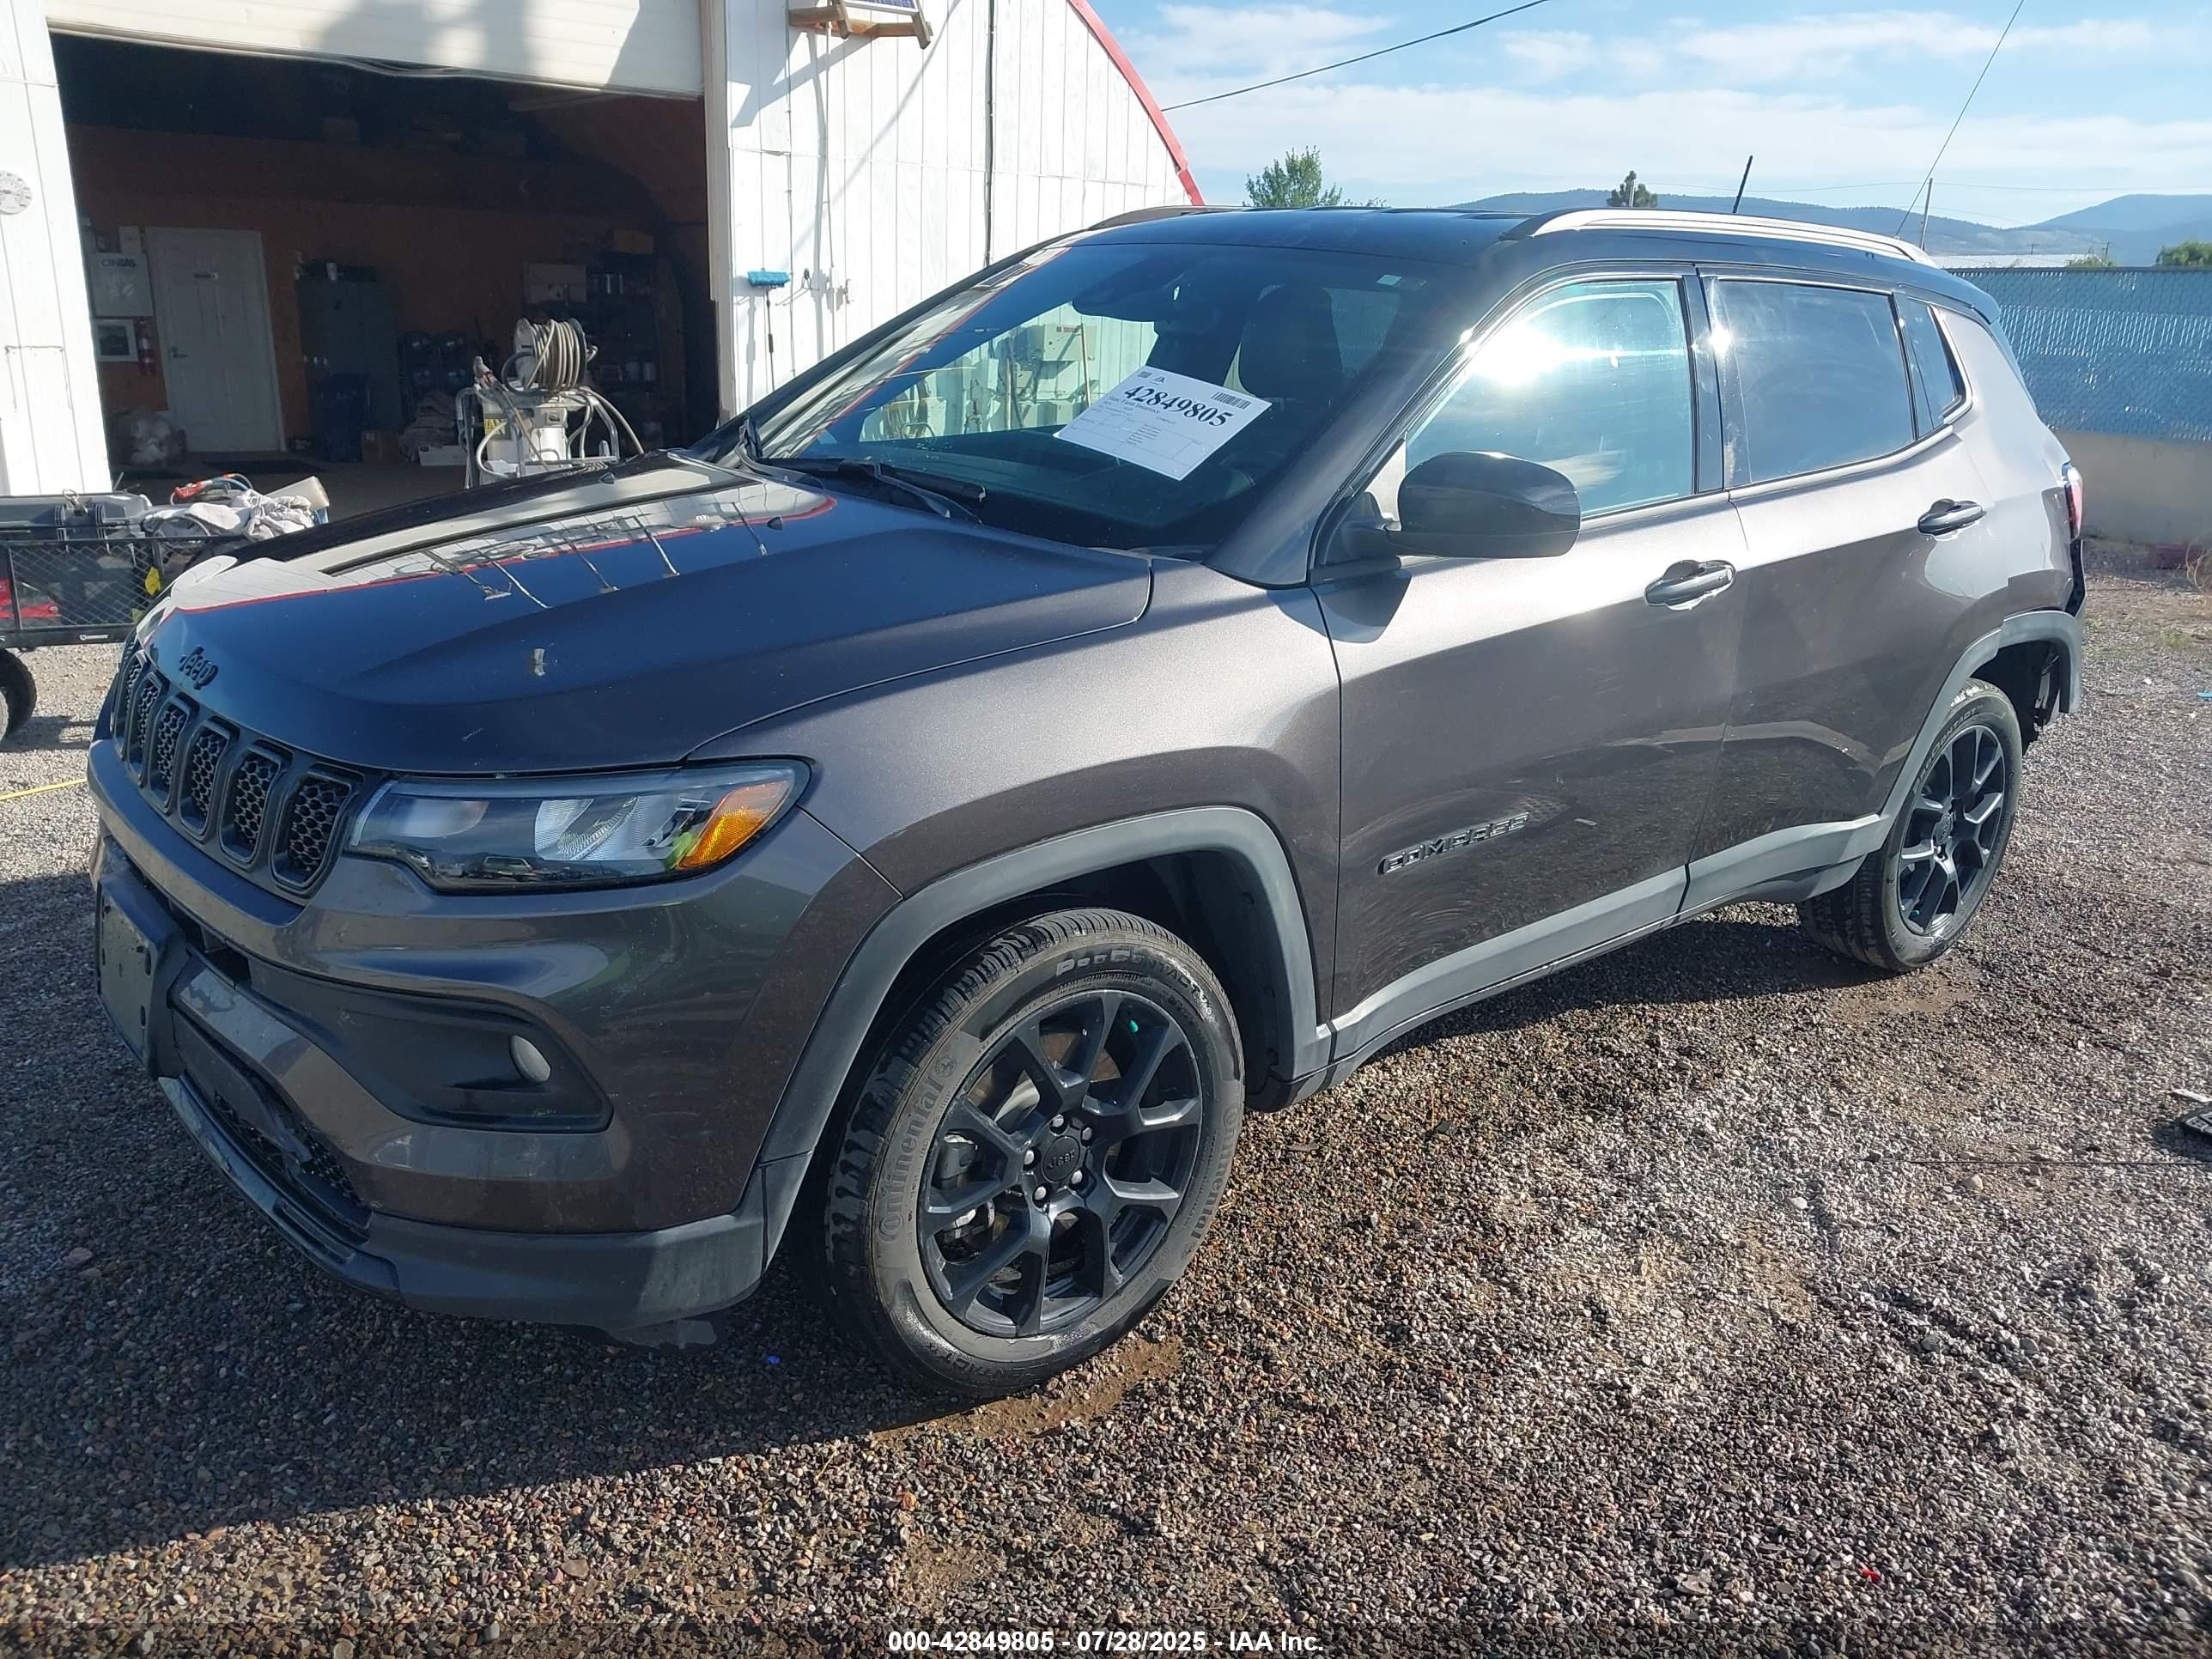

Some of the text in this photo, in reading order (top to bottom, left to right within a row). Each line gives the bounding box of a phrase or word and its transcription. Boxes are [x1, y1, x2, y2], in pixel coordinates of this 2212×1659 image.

[1124, 385, 1234, 427] 42849805
[178, 645, 219, 690] Jeep
[1376, 811, 1529, 875] COMPASS
[876, 1075, 945, 1243] Continental
